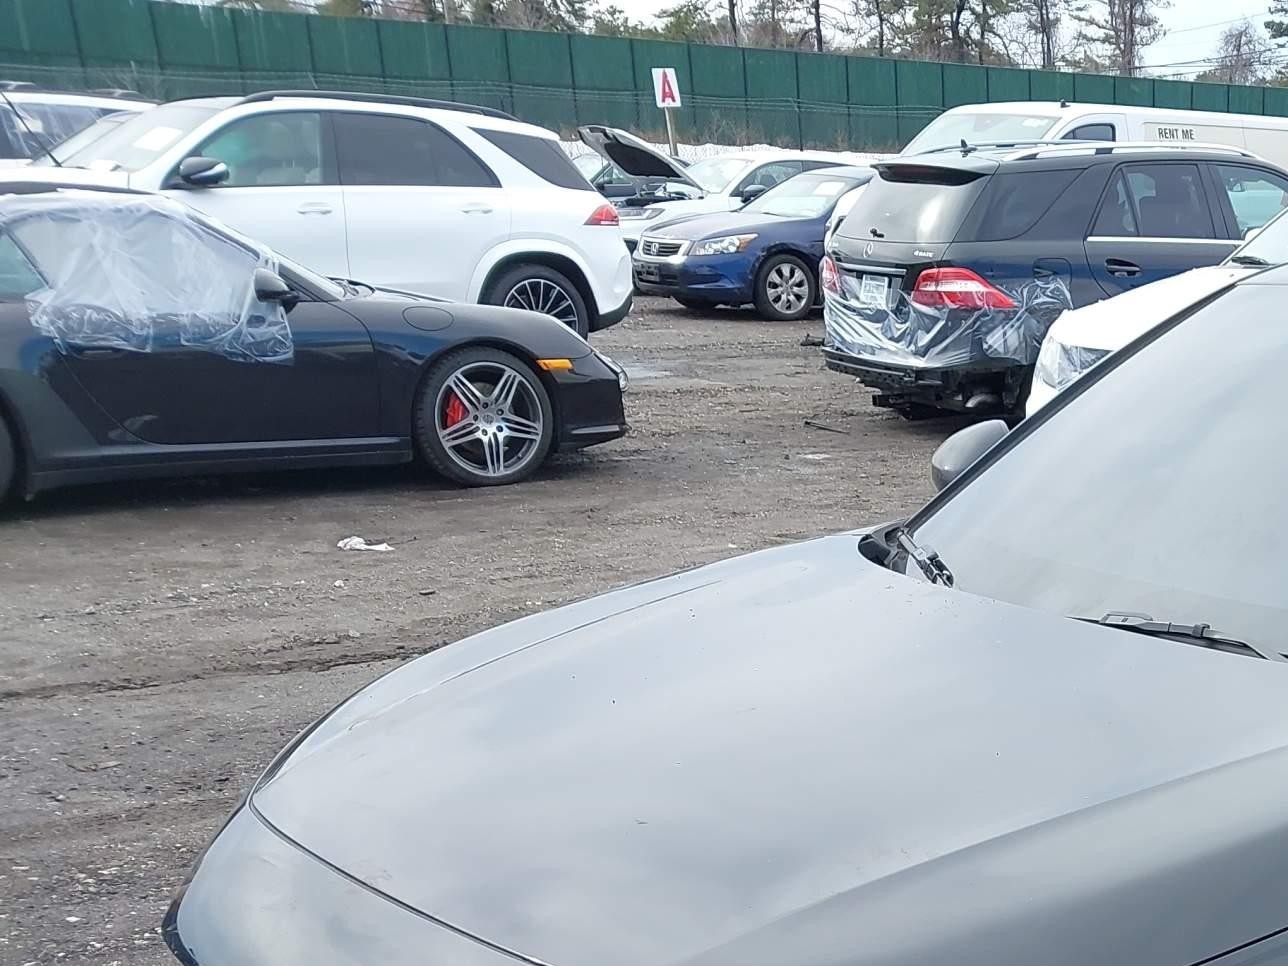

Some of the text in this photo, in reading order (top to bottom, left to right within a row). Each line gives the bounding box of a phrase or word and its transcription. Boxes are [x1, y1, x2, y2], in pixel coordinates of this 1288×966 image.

[661, 69, 676, 103] A
[1158, 127, 1195, 140] RENT ME
